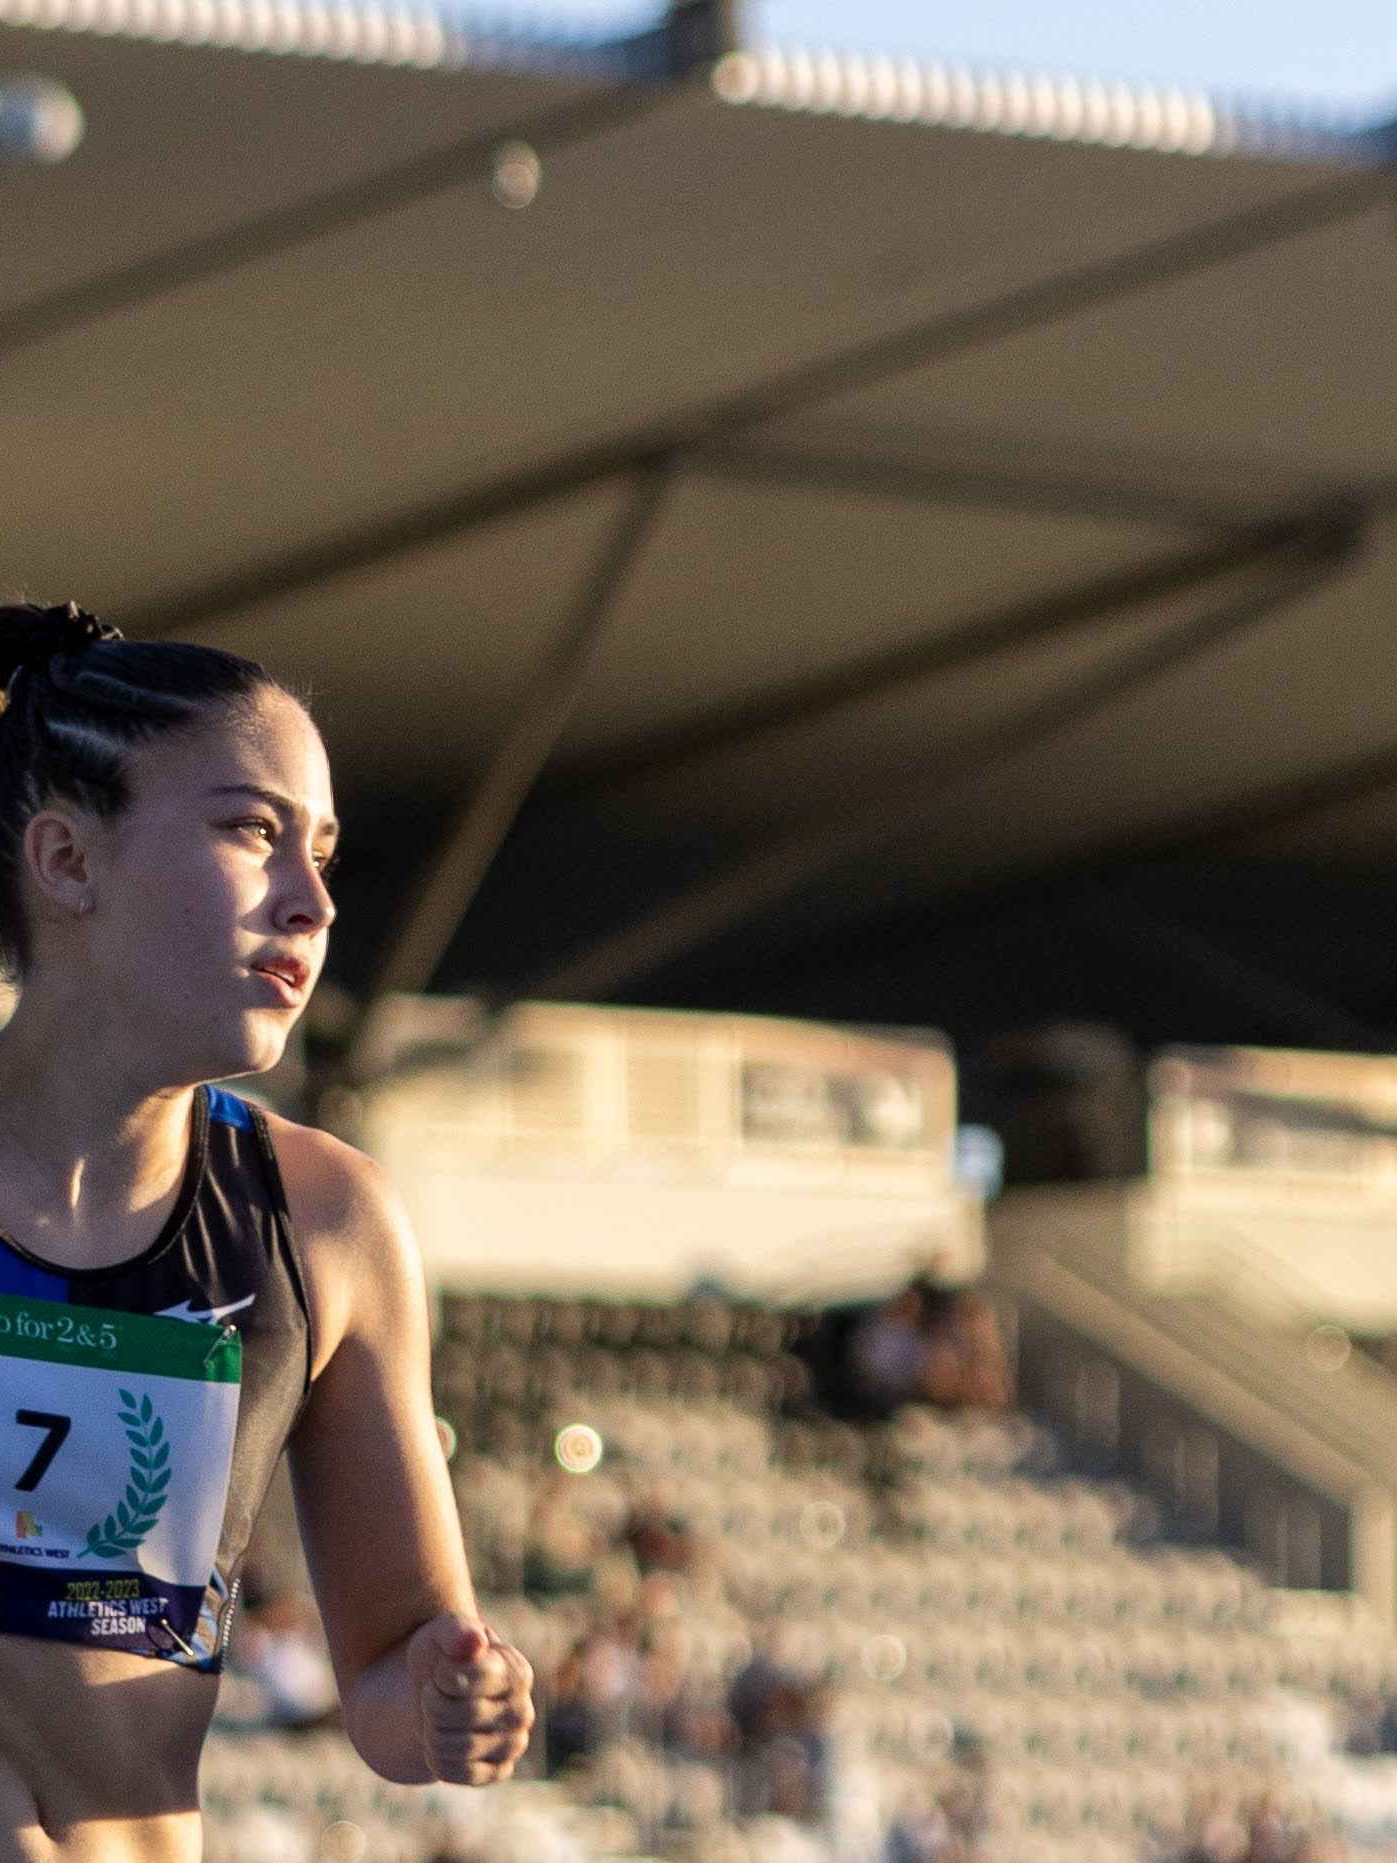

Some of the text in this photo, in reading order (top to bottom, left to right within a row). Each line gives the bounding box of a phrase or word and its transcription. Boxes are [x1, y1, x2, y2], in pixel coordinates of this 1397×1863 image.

[16, 1311, 53, 1340] for
[15, 1408, 72, 1492] 7
[47, 1597, 169, 1618] ATHLETICS WEST
[90, 1615, 147, 1636] SEASON
